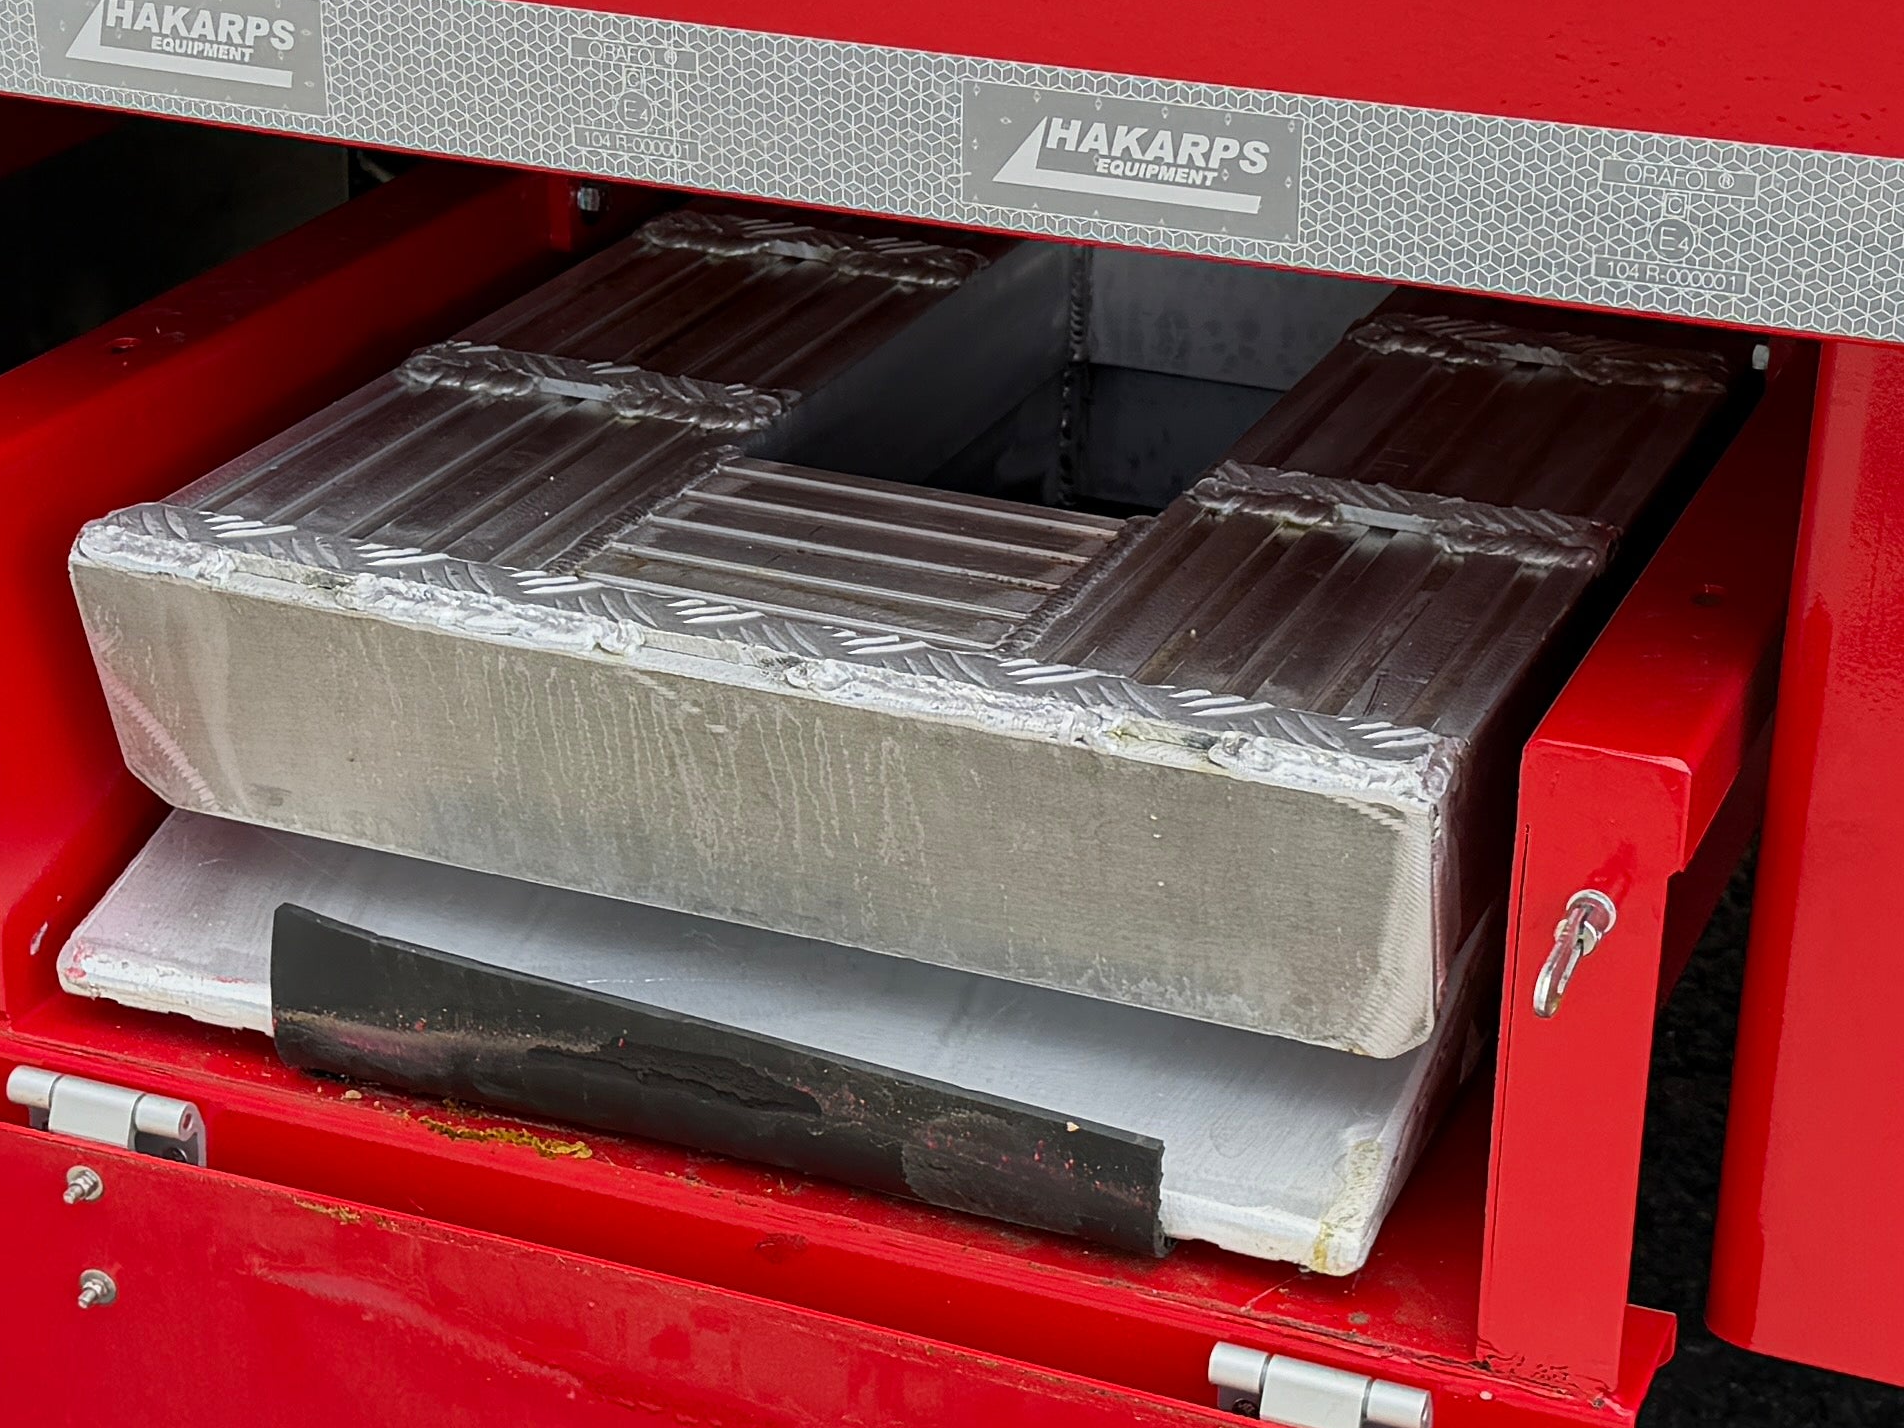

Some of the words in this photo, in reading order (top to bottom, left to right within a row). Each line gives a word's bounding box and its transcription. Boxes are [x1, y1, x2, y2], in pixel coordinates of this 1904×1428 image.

[151, 36, 254, 62] EQUIPMENT
[1045, 117, 1270, 174] HAKARPS
[1096, 159, 1218, 187] EQUIPMENT
[1667, 197, 1683, 214] C
[1607, 261, 1640, 279] 104
